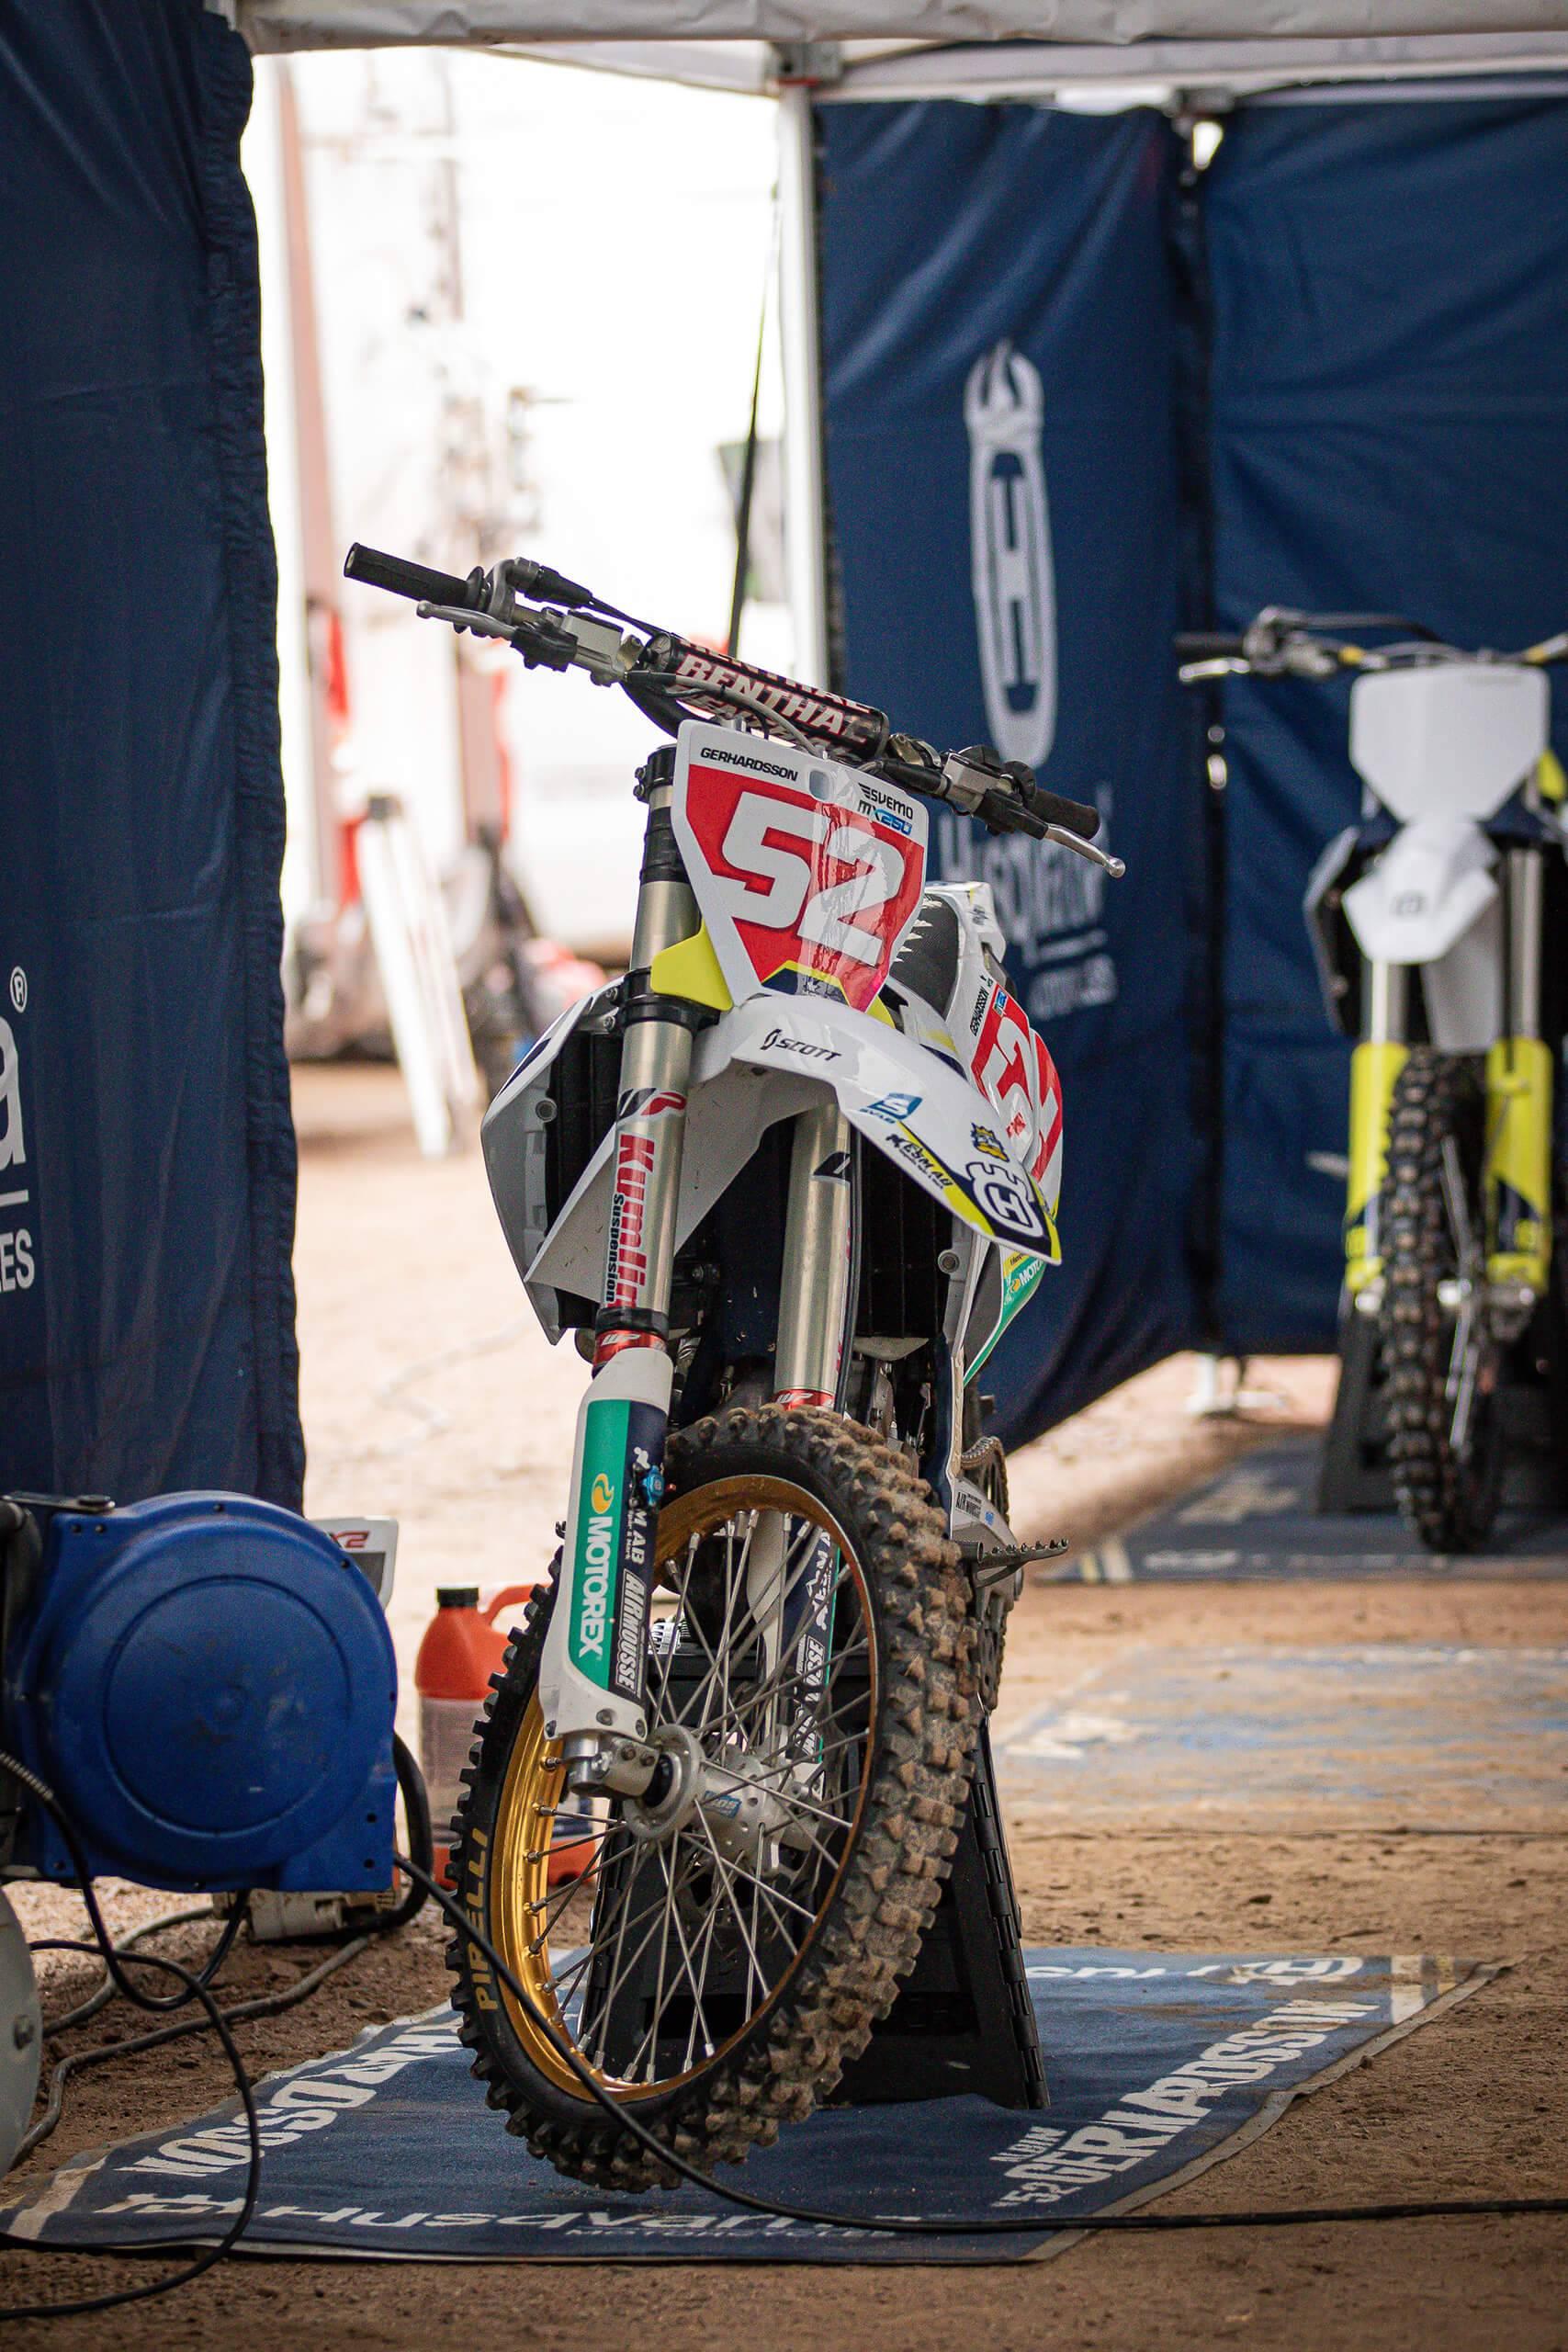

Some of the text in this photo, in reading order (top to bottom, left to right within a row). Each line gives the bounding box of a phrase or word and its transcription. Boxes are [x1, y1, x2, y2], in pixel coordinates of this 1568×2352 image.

[700, 747, 799, 782] GERHARDSSON
[721, 790, 905, 967] 52
[774, 1037, 842, 1061] SCOTT
[605, 1193, 625, 1303] Suspension
[606, 1133, 656, 1308] Kumlin
[578, 1515, 614, 1659] MOTOREX
[617, 1572, 646, 1694] AIRMOUSSE
[466, 1826, 498, 2011] PIRELLI
